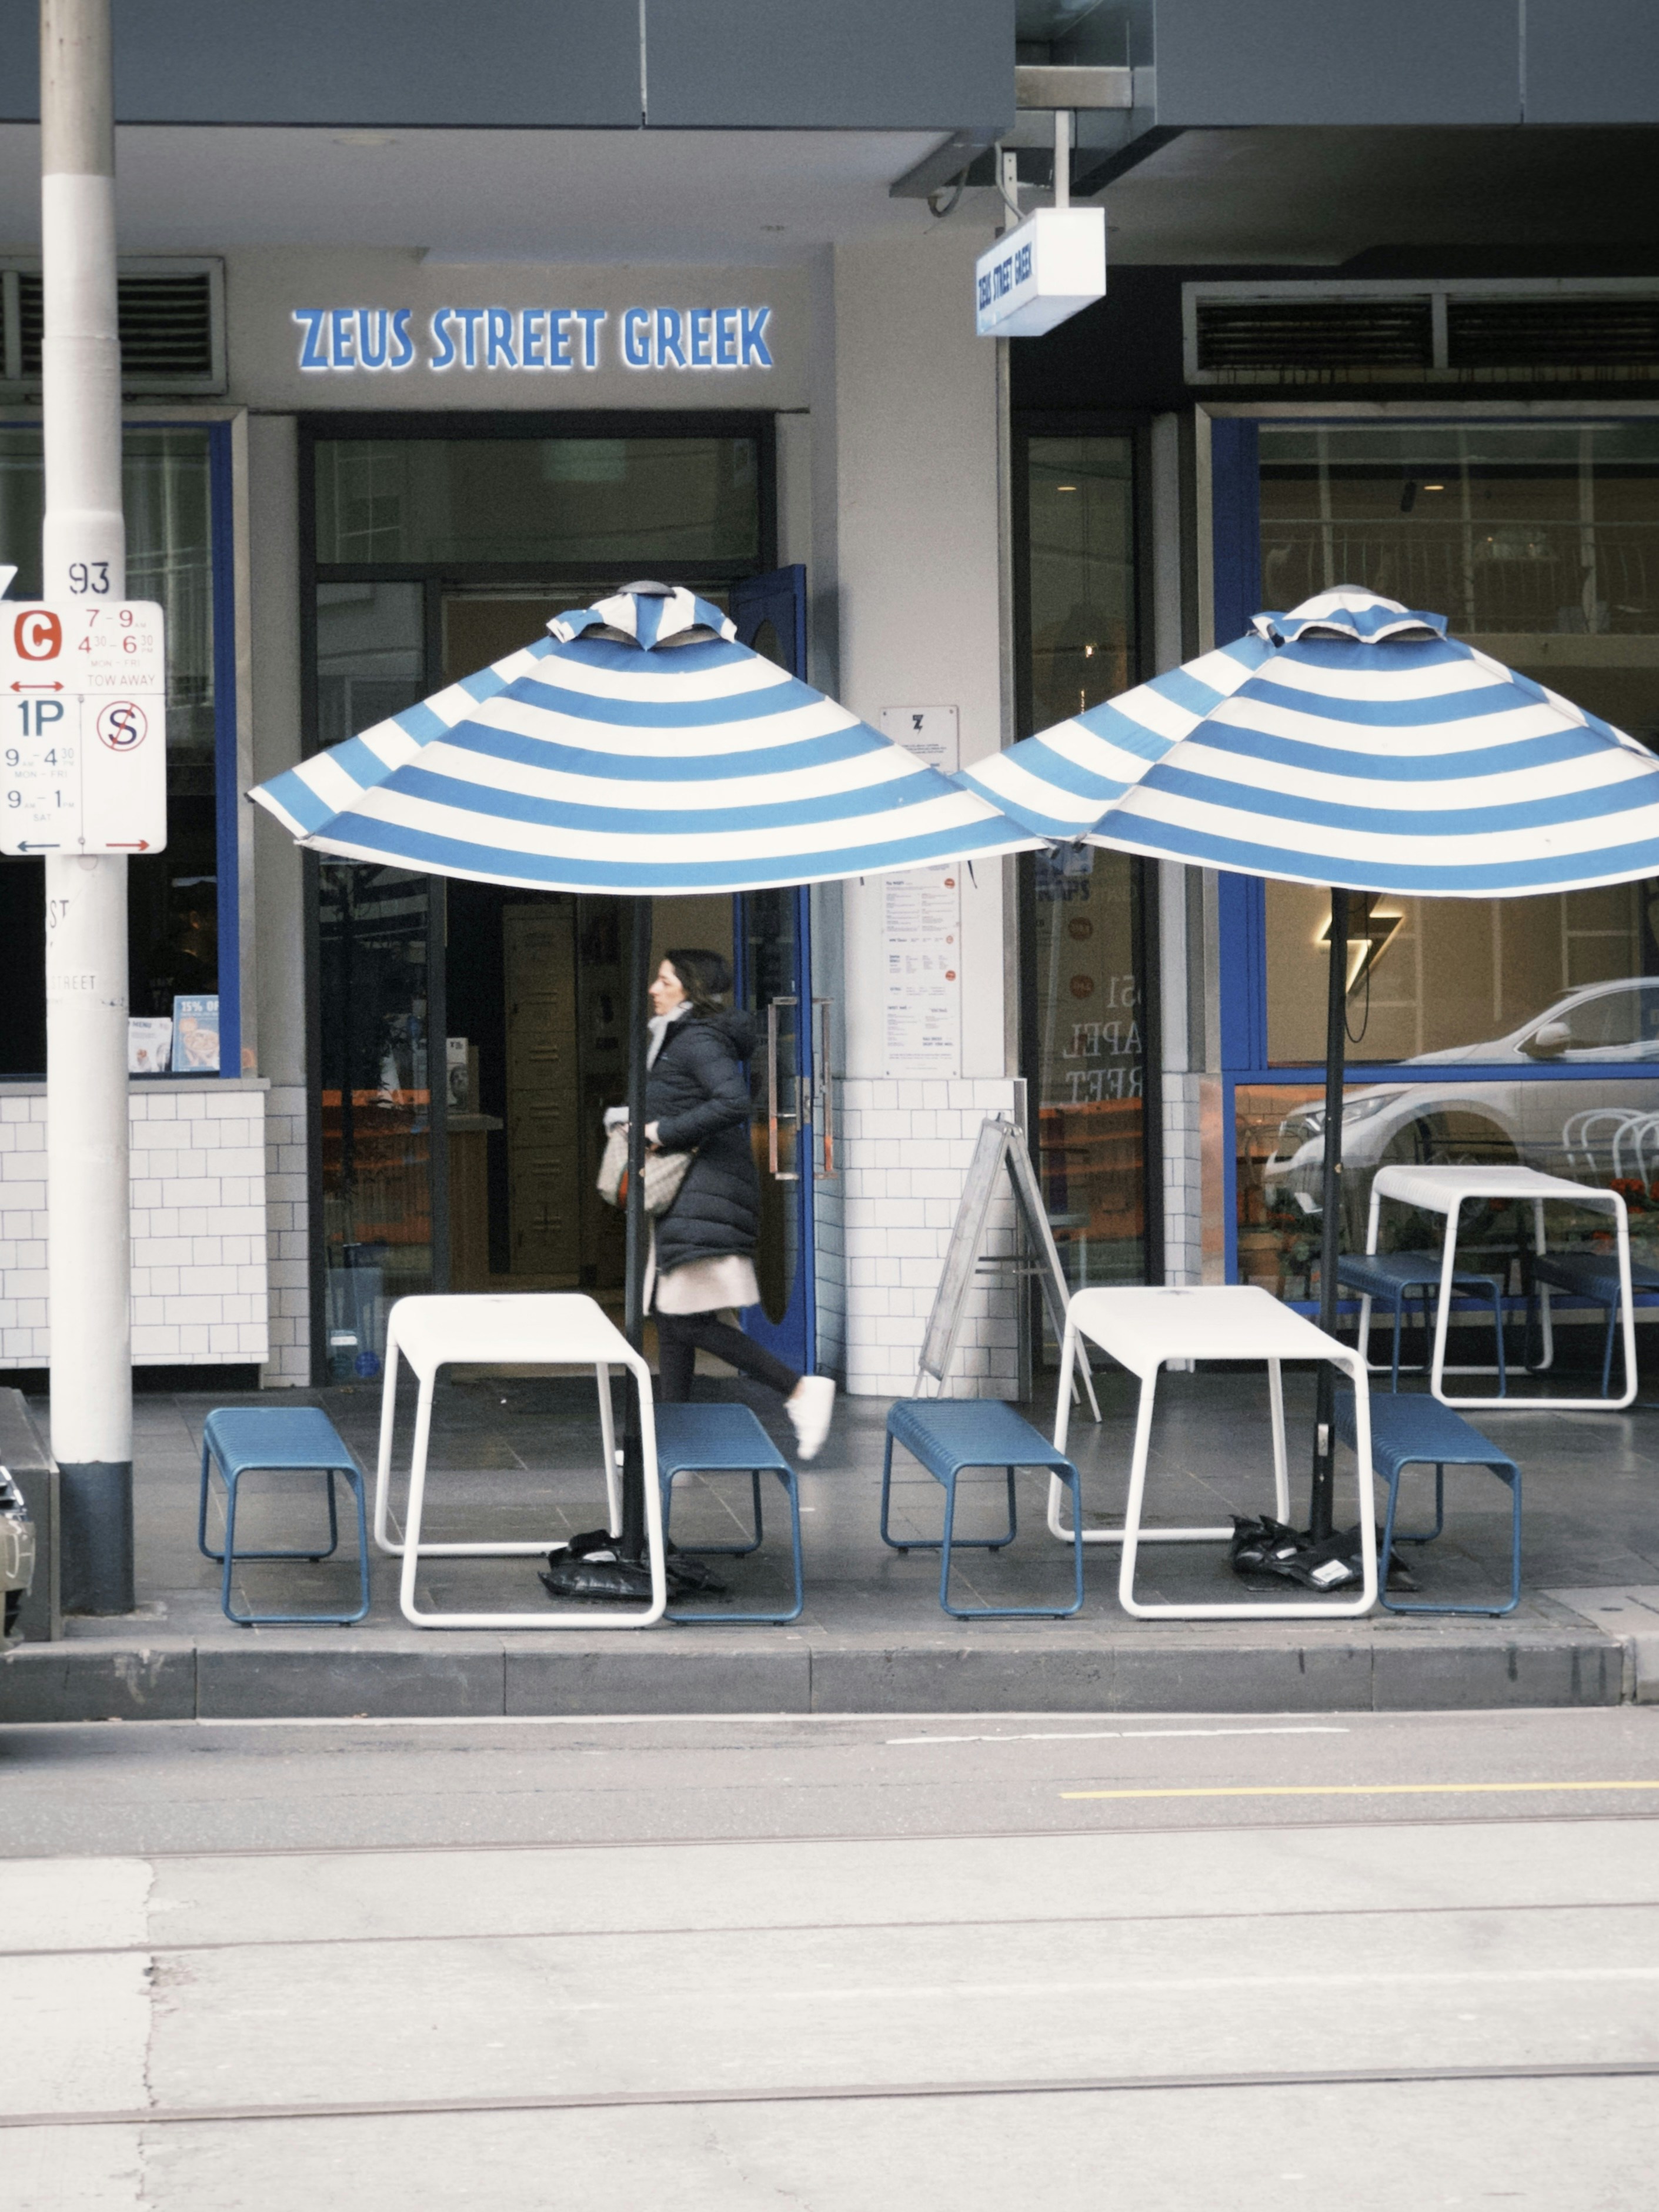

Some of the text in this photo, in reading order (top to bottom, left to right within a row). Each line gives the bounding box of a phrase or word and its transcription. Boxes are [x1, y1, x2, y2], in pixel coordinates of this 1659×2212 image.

[293, 308, 773, 369] ZEUS STREET GREEK
[69, 562, 109, 595] 93
[22, 613, 54, 657] C
[88, 674, 156, 687] TOW AWAY
[18, 700, 64, 736] 1P
[33, 813, 52, 822] SAT
[51, 975, 96, 990] STREET
